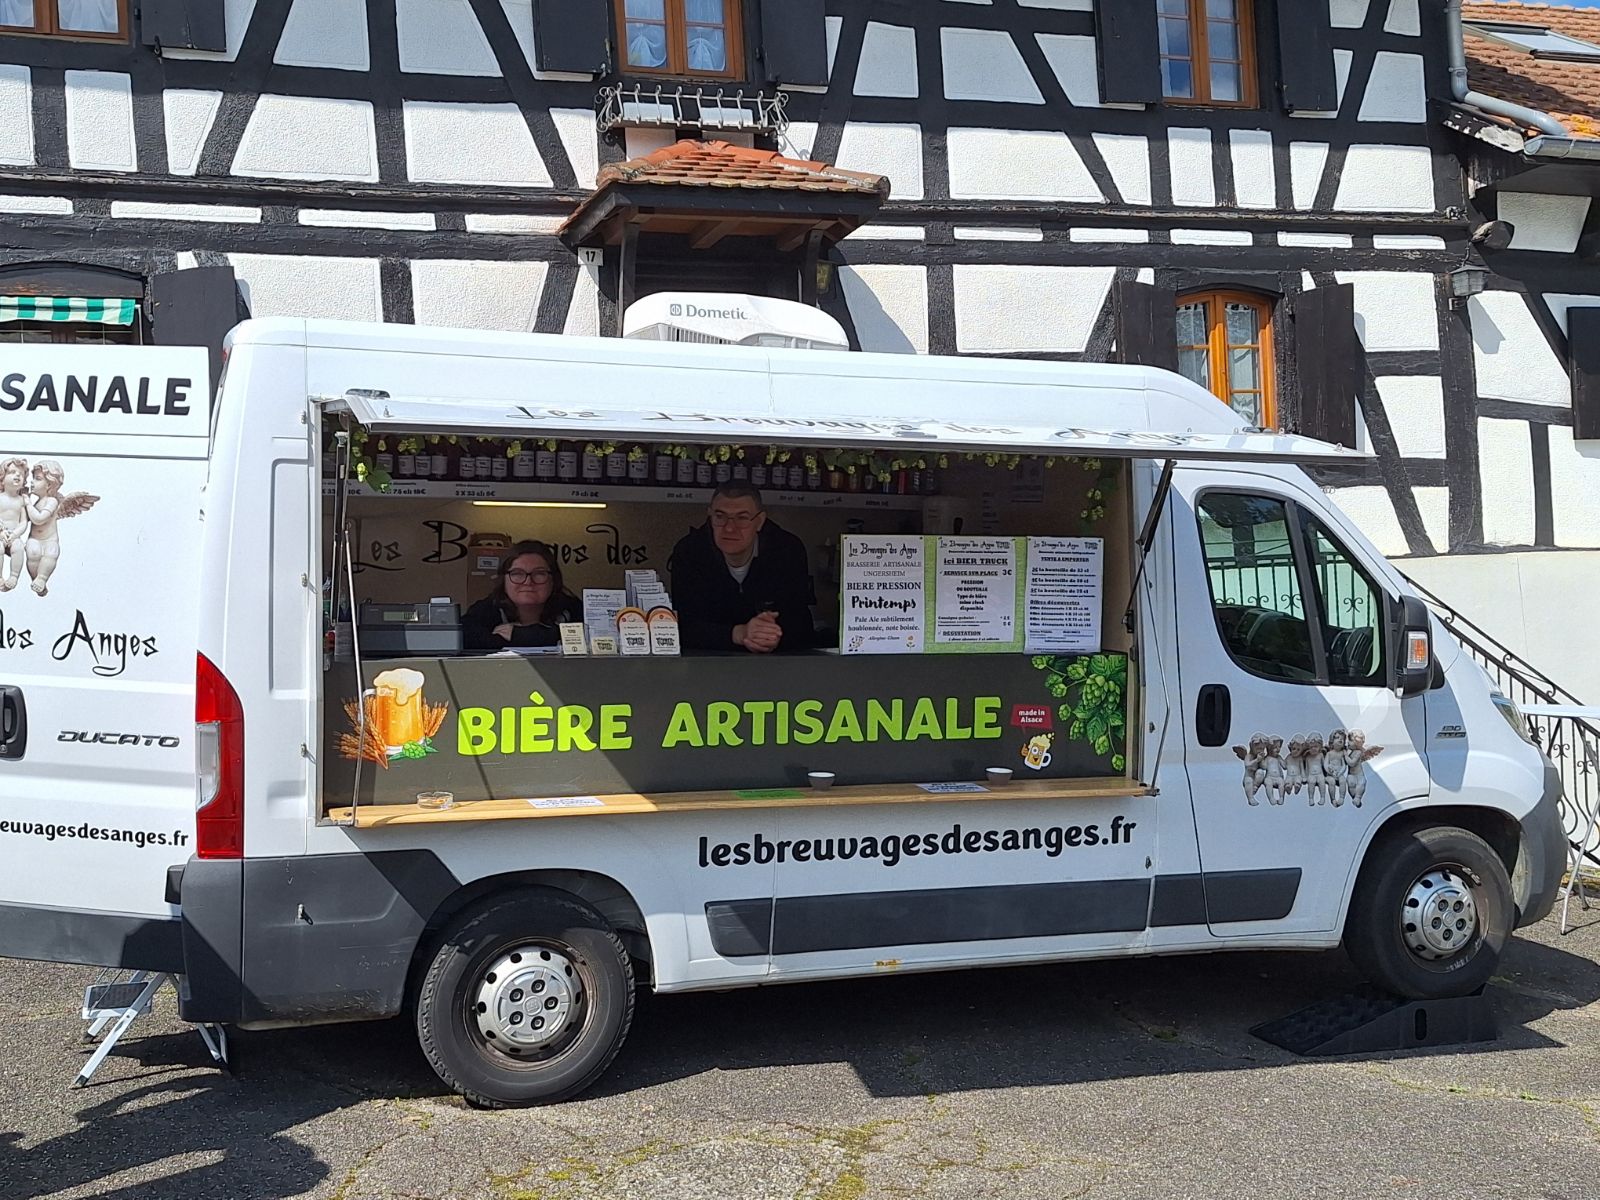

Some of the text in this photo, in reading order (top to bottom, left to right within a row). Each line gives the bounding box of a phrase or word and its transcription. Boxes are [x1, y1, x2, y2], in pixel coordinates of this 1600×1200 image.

[585, 251, 596, 262] 17
[686, 304, 749, 320] Dometic
[0, 373, 192, 416] SANALE
[586, 523, 648, 565] des
[847, 582, 922, 591] BIERE PRESSION
[851, 595, 917, 613] Printemps
[51, 609, 159, 677] Anges
[457, 691, 1002, 756] BIÈRE ARTISANALE
[57, 731, 180, 748] DUCATO
[698, 815, 1138, 868] lesbreuvagesdesanges.fr
